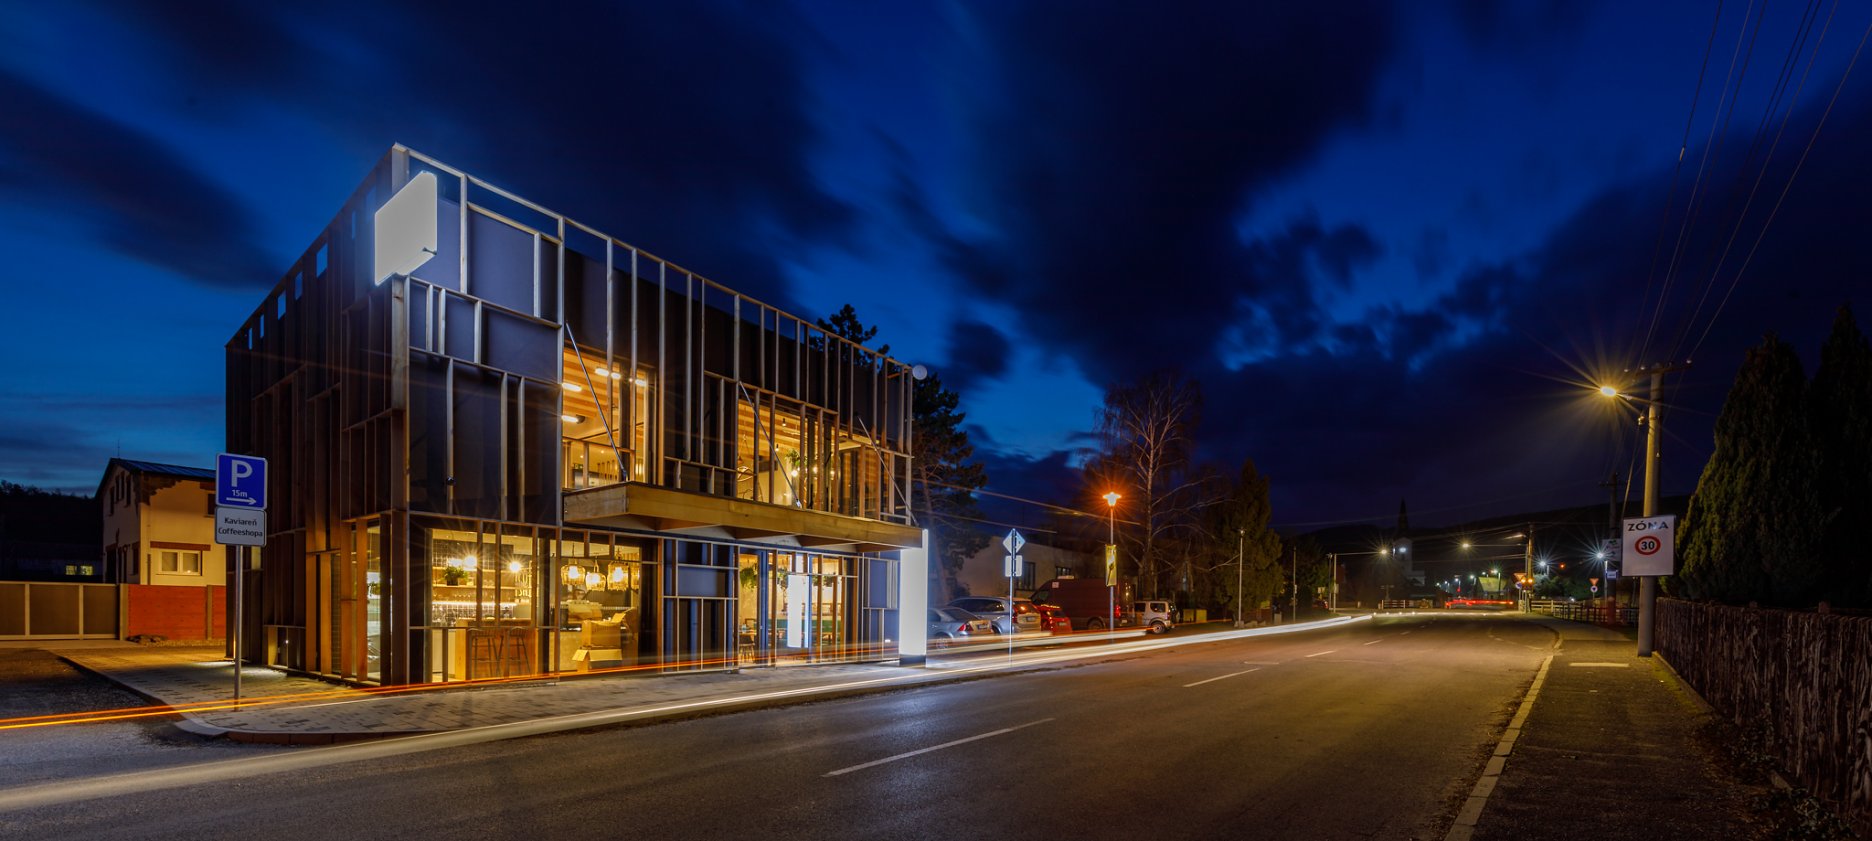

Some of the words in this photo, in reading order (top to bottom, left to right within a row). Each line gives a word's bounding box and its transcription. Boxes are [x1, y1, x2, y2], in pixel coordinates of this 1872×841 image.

[231, 459, 252, 487] P
[231, 489, 247, 497] 15m
[1628, 521, 1668, 531] ZÓNA
[218, 527, 263, 537] Coffeeshopa
[1641, 541, 1655, 550] 30
